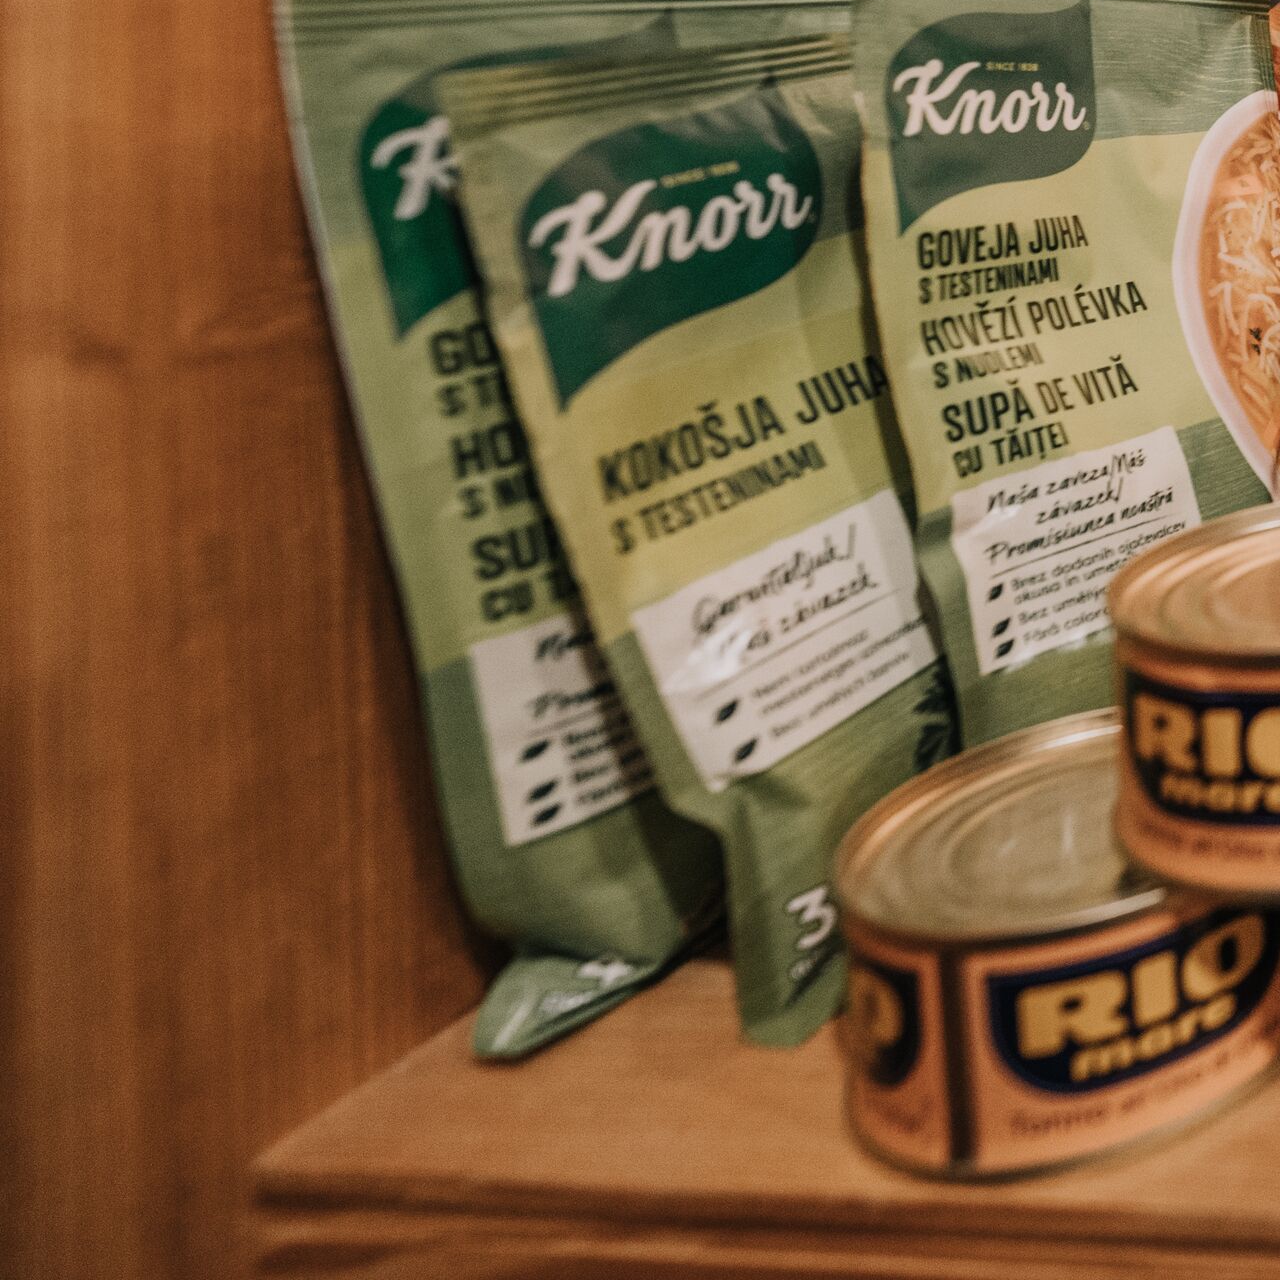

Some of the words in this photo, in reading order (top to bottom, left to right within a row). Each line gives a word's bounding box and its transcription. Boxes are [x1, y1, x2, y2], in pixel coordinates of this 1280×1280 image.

[893, 58, 1087, 137] Knorr
[528, 173, 813, 298] Knorr
[918, 222, 1021, 270] GOVEJA
[1029, 215, 1089, 254] JUHA
[919, 277, 933, 305] S
[938, 257, 1059, 302] TESTENINAMI
[920, 295, 1023, 356] HOVĚZÍ
[1027, 281, 1148, 335] POLÉVKA
[933, 361, 950, 389] S
[942, 377, 1035, 444] SUPĂ
[1036, 377, 1075, 415] DE
[1072, 354, 1139, 406] VITĂ
[597, 396, 785, 506] KOKOŠJA
[795, 353, 890, 425] JUHA
[610, 518, 636, 556] S
[638, 439, 828, 541] TESTENINAMI
[987, 485, 1038, 514] Naša
[1015, 914, 1266, 1060] RIO
[1069, 993, 1238, 1083] mare
